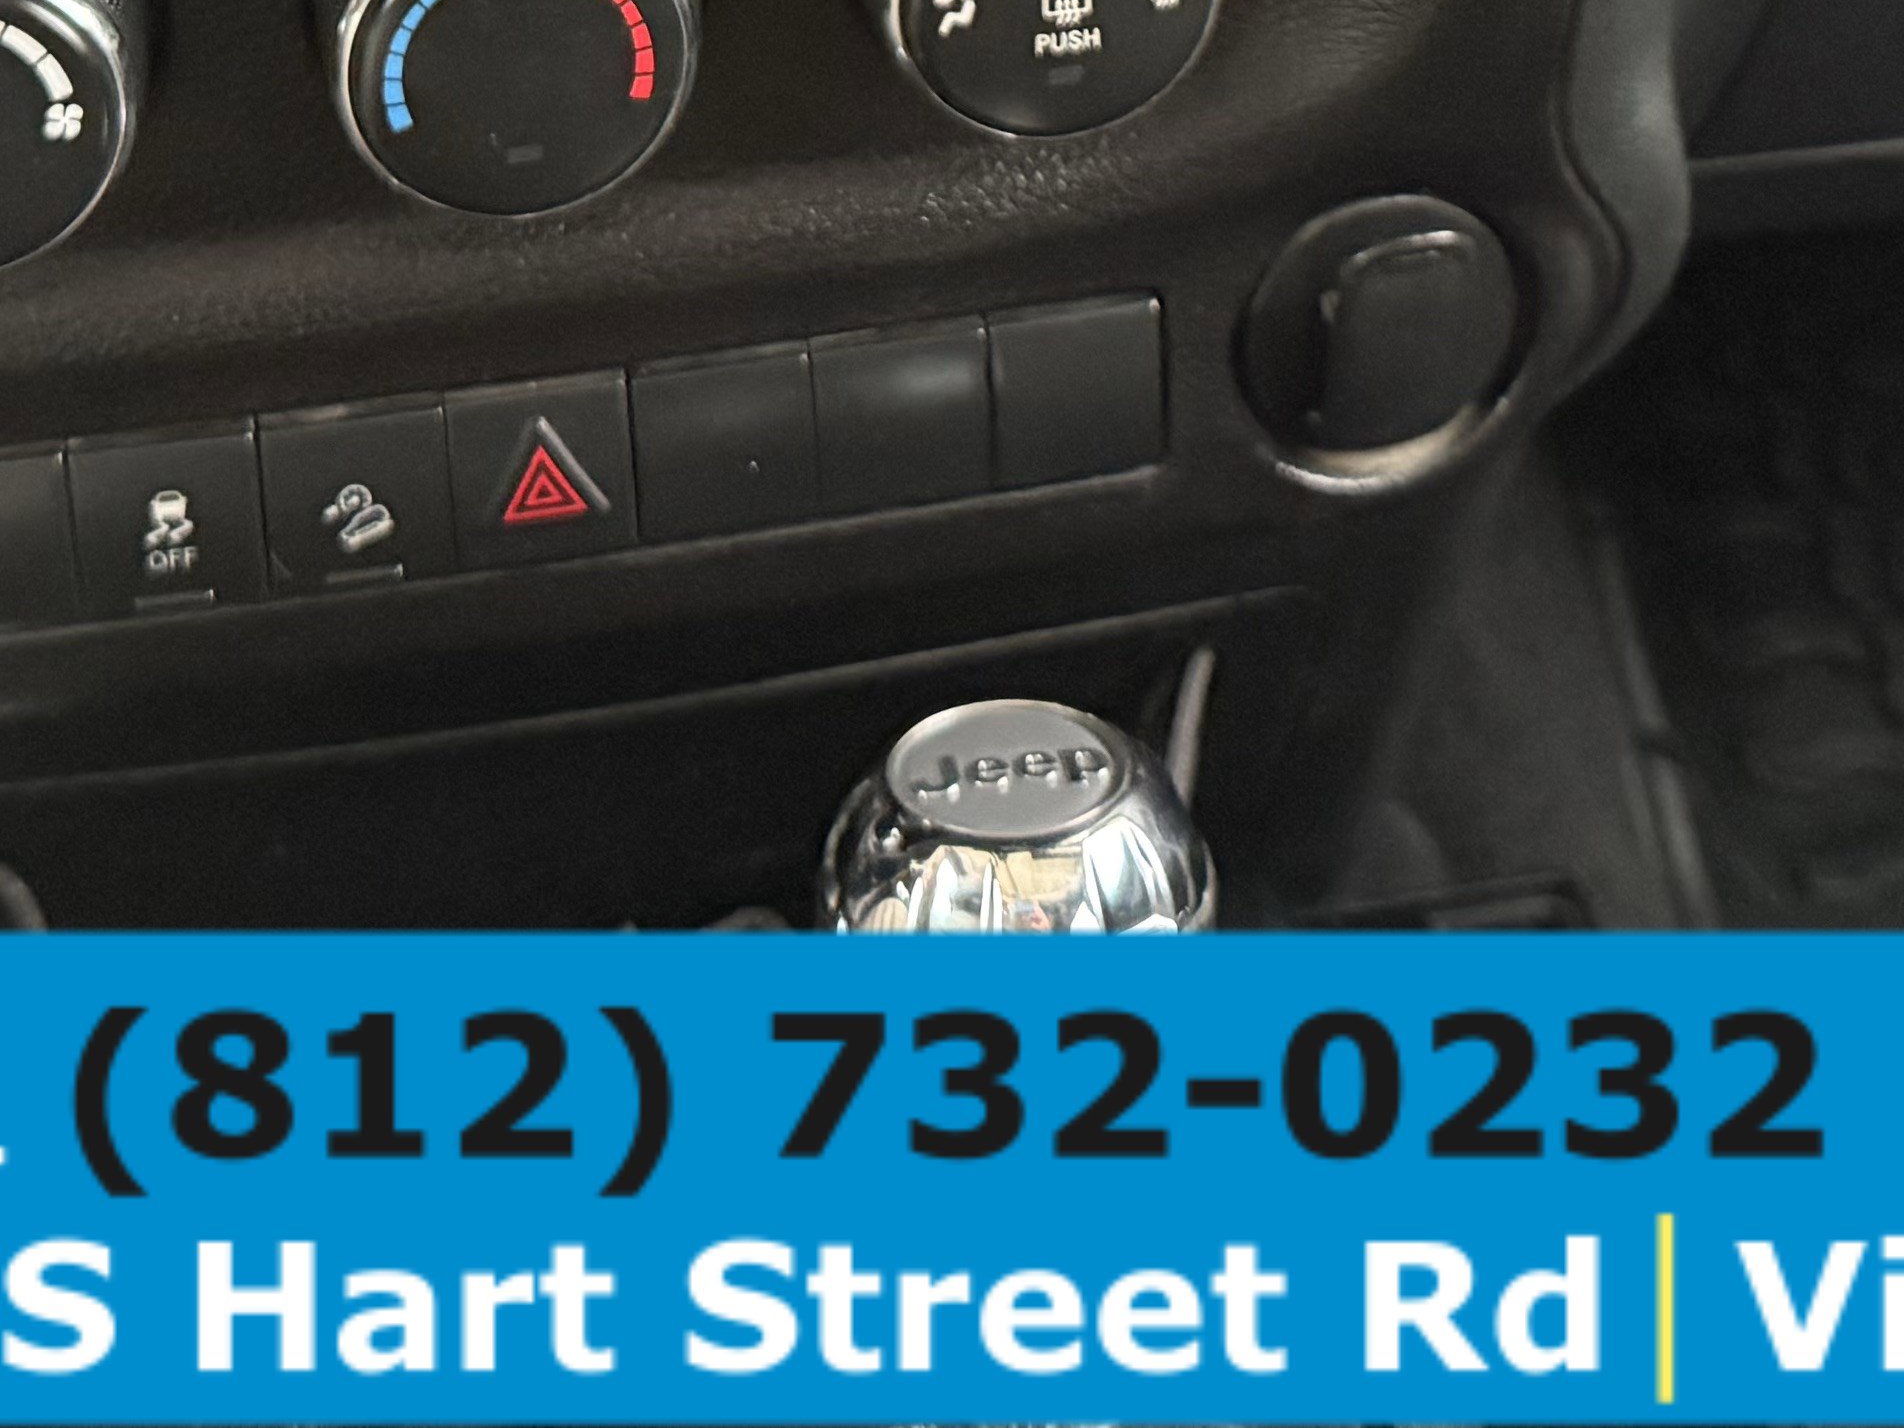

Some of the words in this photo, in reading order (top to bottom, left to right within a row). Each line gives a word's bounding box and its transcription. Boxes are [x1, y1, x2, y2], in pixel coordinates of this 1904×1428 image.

[1034, 26, 1103, 58] PUSH
[148, 545, 197, 572] OFF
[912, 747, 1110, 800] Jeep
